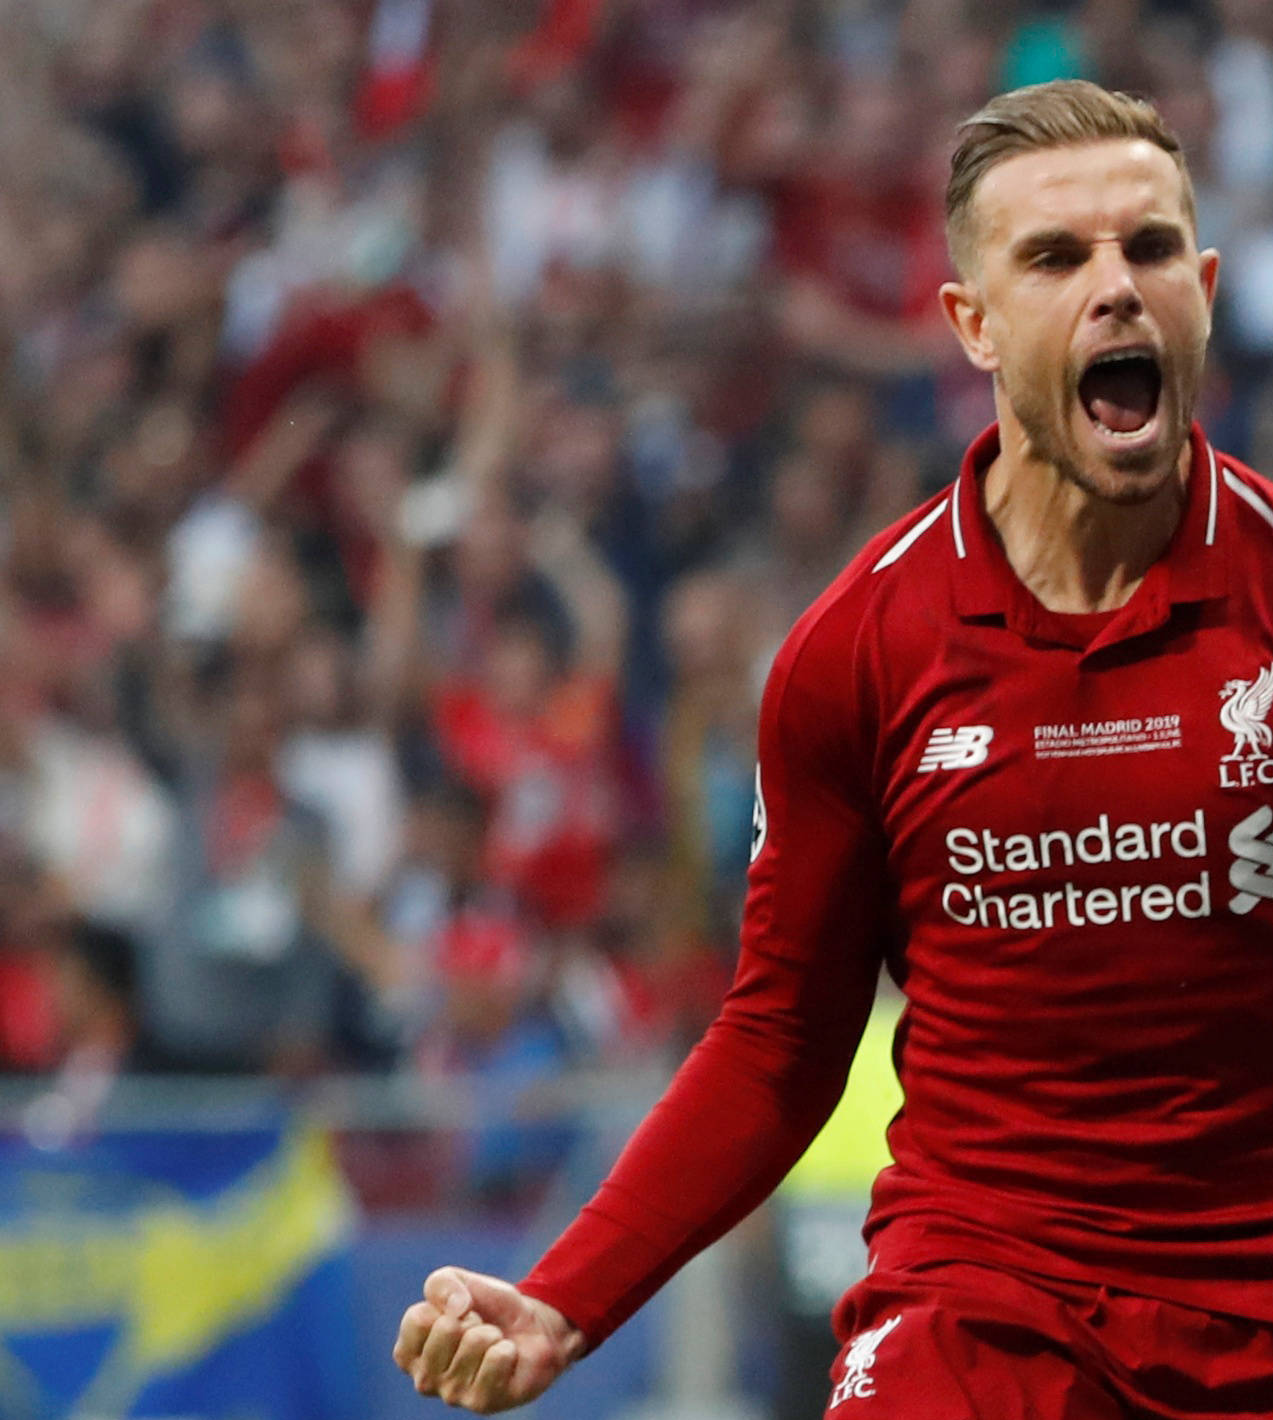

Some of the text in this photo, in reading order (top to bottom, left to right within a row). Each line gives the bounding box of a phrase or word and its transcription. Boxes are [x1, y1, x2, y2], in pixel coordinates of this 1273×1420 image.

[1034, 714, 1181, 740] FINAL MADRID 2019
[945, 809, 1208, 875] Standard
[942, 870, 1212, 930] Chartered
